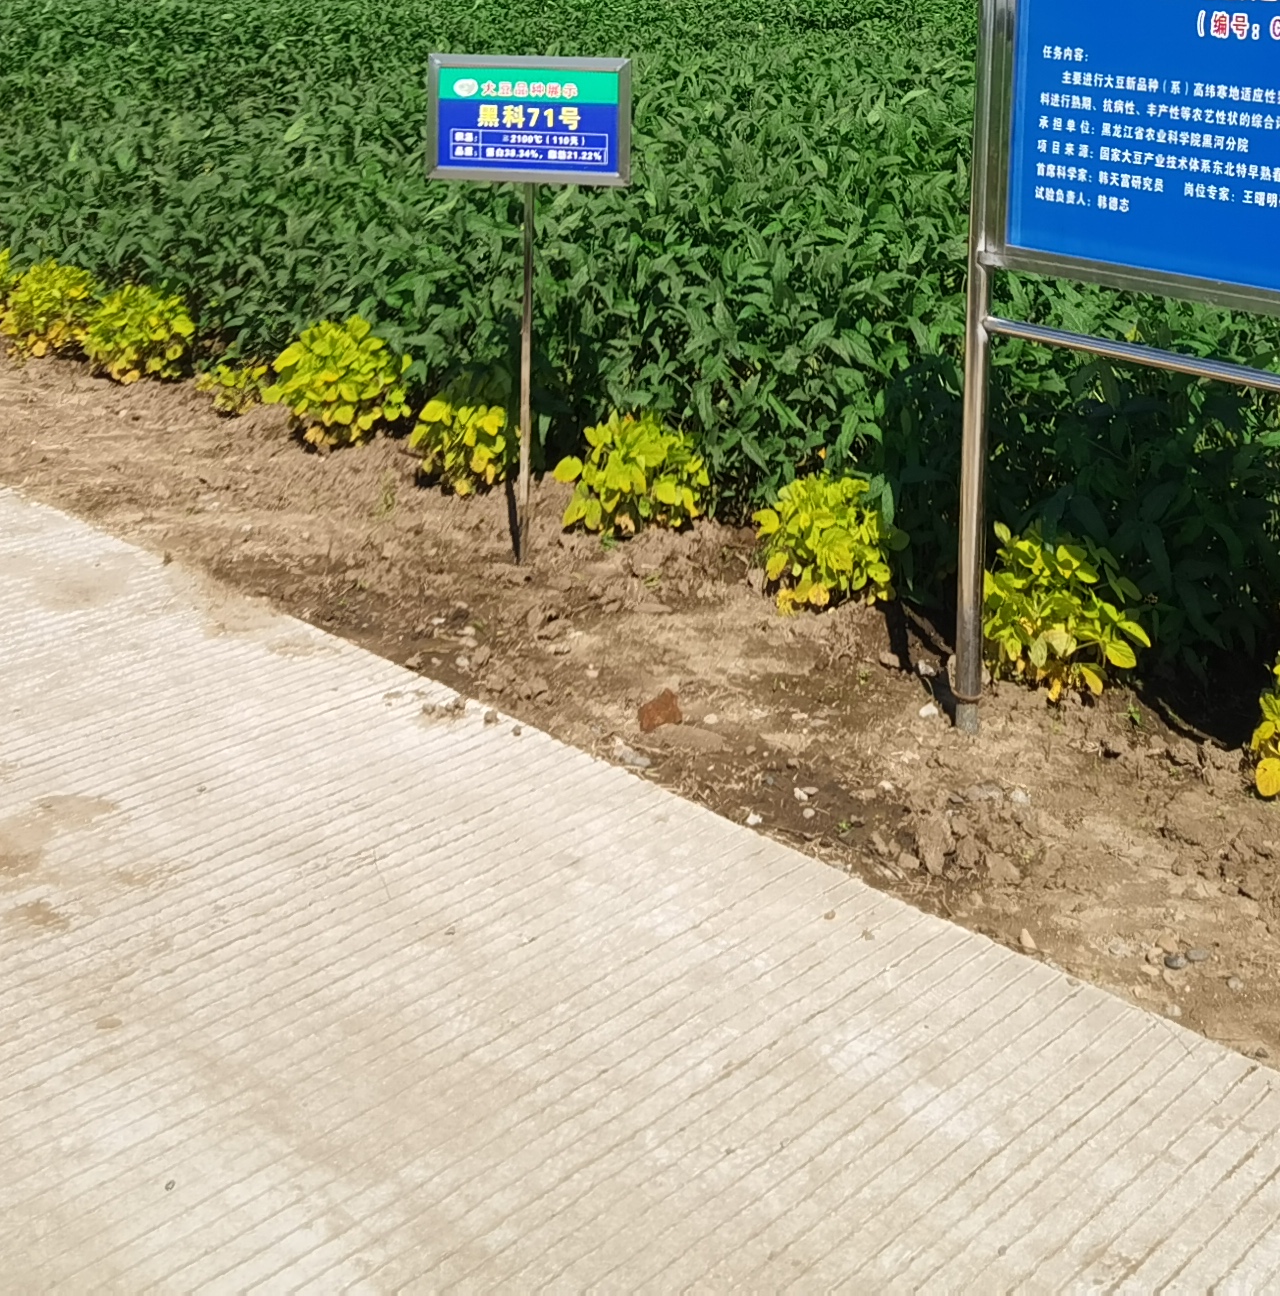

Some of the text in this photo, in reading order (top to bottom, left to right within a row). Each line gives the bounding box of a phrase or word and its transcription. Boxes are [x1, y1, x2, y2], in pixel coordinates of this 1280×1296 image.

[1042, 45, 1089, 62] 任务内容：
[481, 80, 578, 99] 大豆品种展示
[477, 104, 581, 130] 黑科71号
